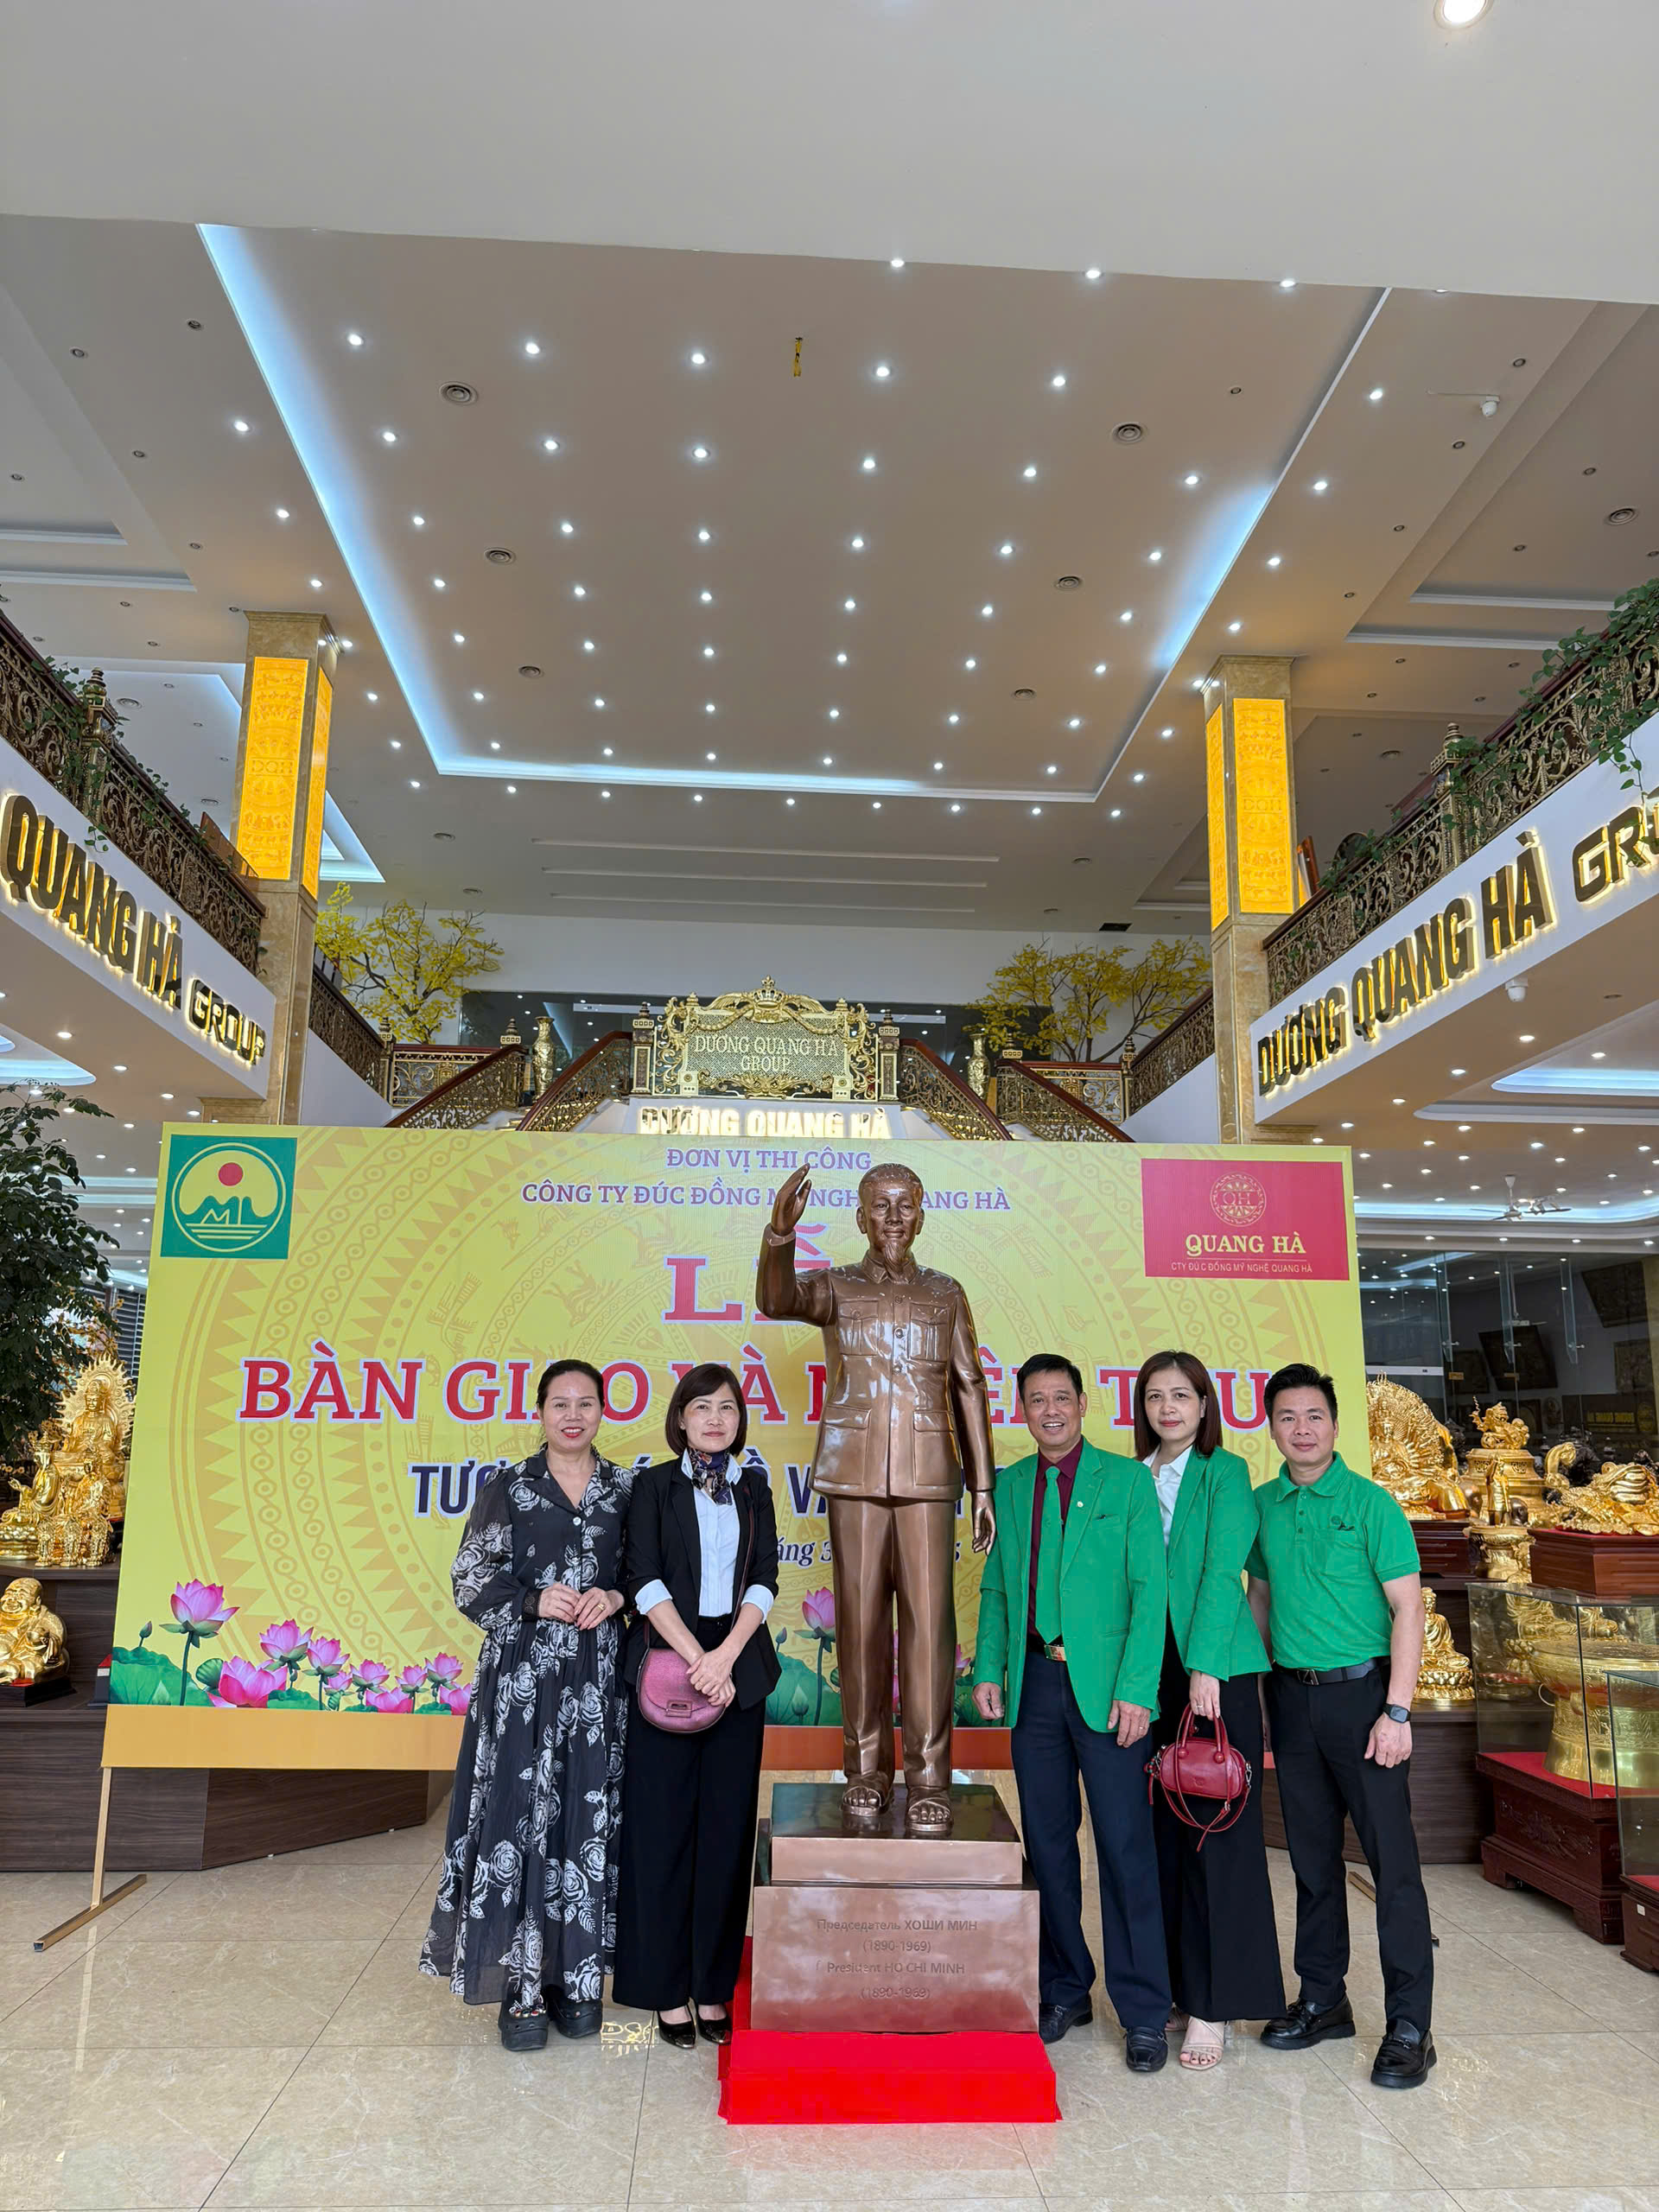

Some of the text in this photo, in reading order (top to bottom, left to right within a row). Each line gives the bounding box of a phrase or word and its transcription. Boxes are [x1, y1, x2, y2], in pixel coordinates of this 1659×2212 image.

[2, 794, 137, 974] QUANG
[188, 978, 266, 1066] GROUP
[1352, 897, 1474, 1041] QUANG
[1480, 830, 1554, 960] HÀ
[1573, 801, 1659, 903] GR
[754, 1037, 810, 1055] QUANG
[741, 1055, 790, 1071] GROUP
[747, 1109, 844, 1137] QUANG
[850, 1106, 892, 1139] HÀ
[667, 1146, 872, 1173] ĐƠN VỊ THI CÔNG
[522, 1179, 592, 1203] CÔNG
[598, 1185, 628, 1203] TY
[633, 1180, 685, 1205] ĐÚC
[690, 1176, 761, 1206] ĐỒNG
[975, 1187, 1010, 1210] HÀ
[1223, 1192, 1250, 1205] QH
[1185, 1231, 1306, 1256] QUANG HÀ
[1171, 1262, 1185, 1271] CTY
[1272, 1263, 1300, 1273] QUANG
[239, 1341, 423, 1421] BÀN
[446, 1361, 650, 1421] GIO
[817, 1919, 977, 1932] Председатель ХОШИ МИН
[863, 1940, 931, 1953] (1890-1969)
[827, 1962, 965, 1974] President HO CHI MINH
[861, 1986, 931, 1999] (1890-1969)
